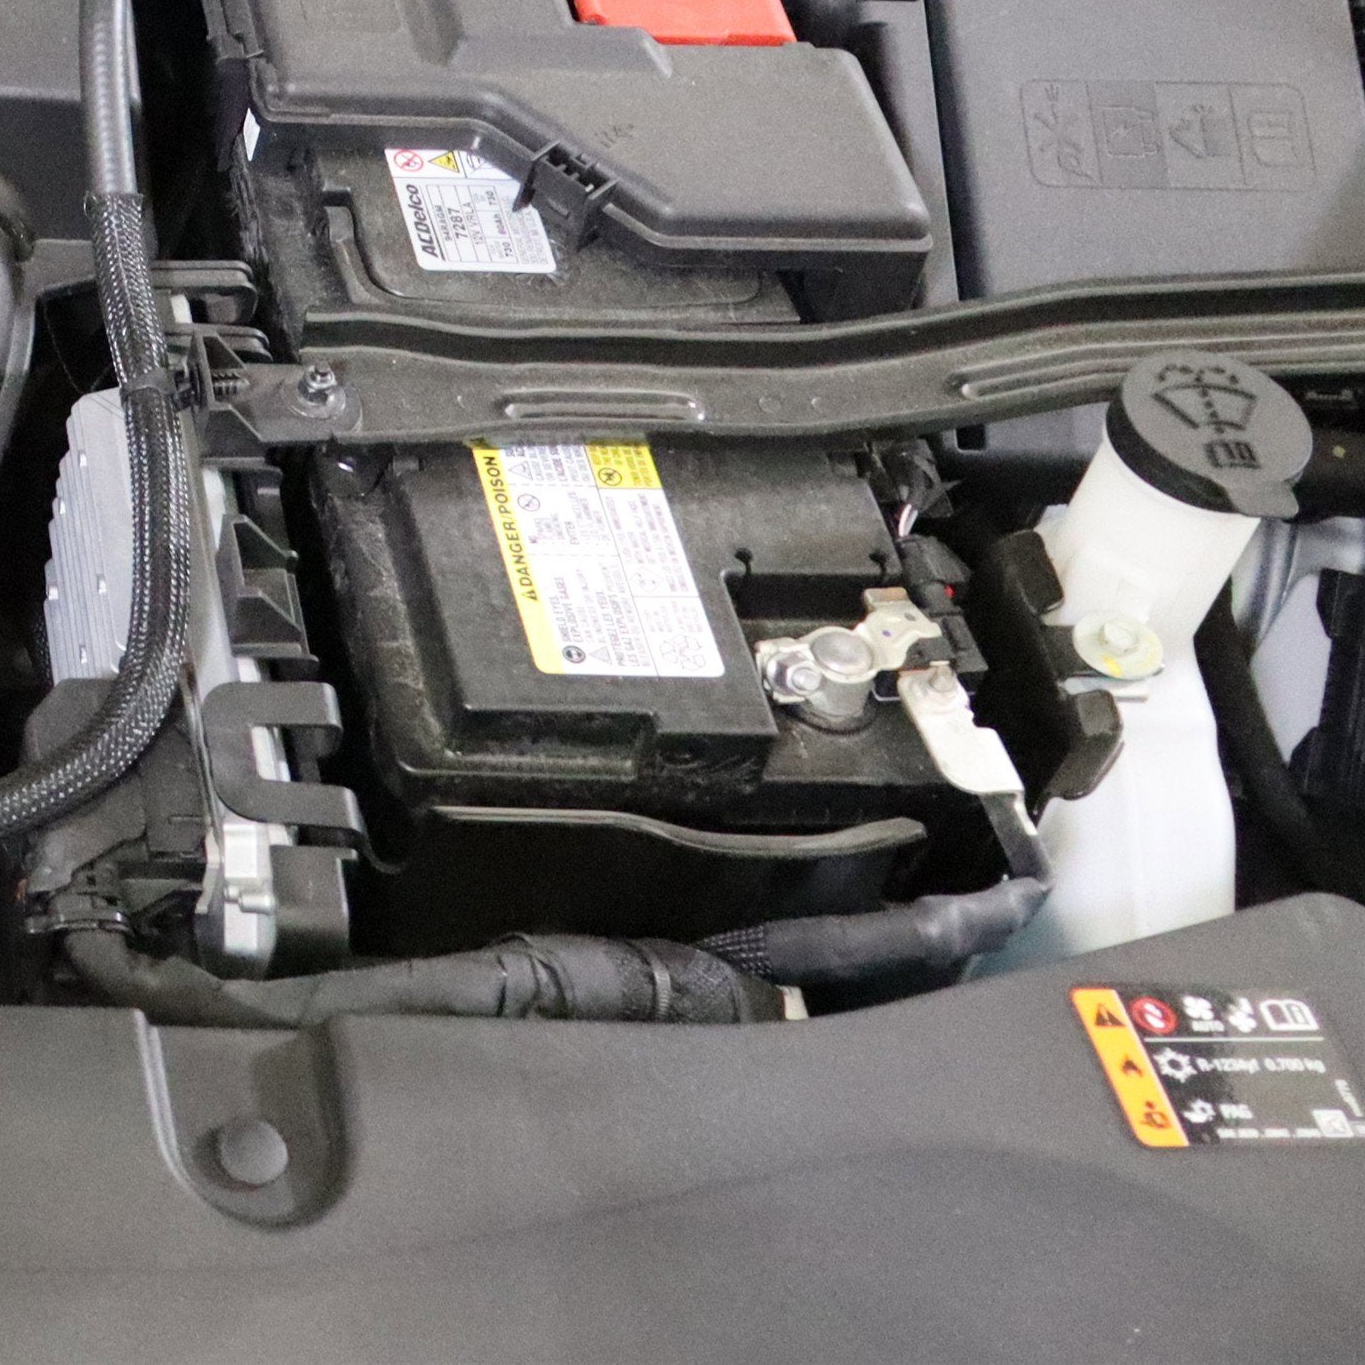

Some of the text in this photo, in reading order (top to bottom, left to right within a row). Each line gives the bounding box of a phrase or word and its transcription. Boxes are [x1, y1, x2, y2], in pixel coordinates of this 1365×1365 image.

[406, 184, 439, 258] ACDelco
[448, 207, 468, 239] 7287
[482, 455, 533, 588] DANGER/POISON
